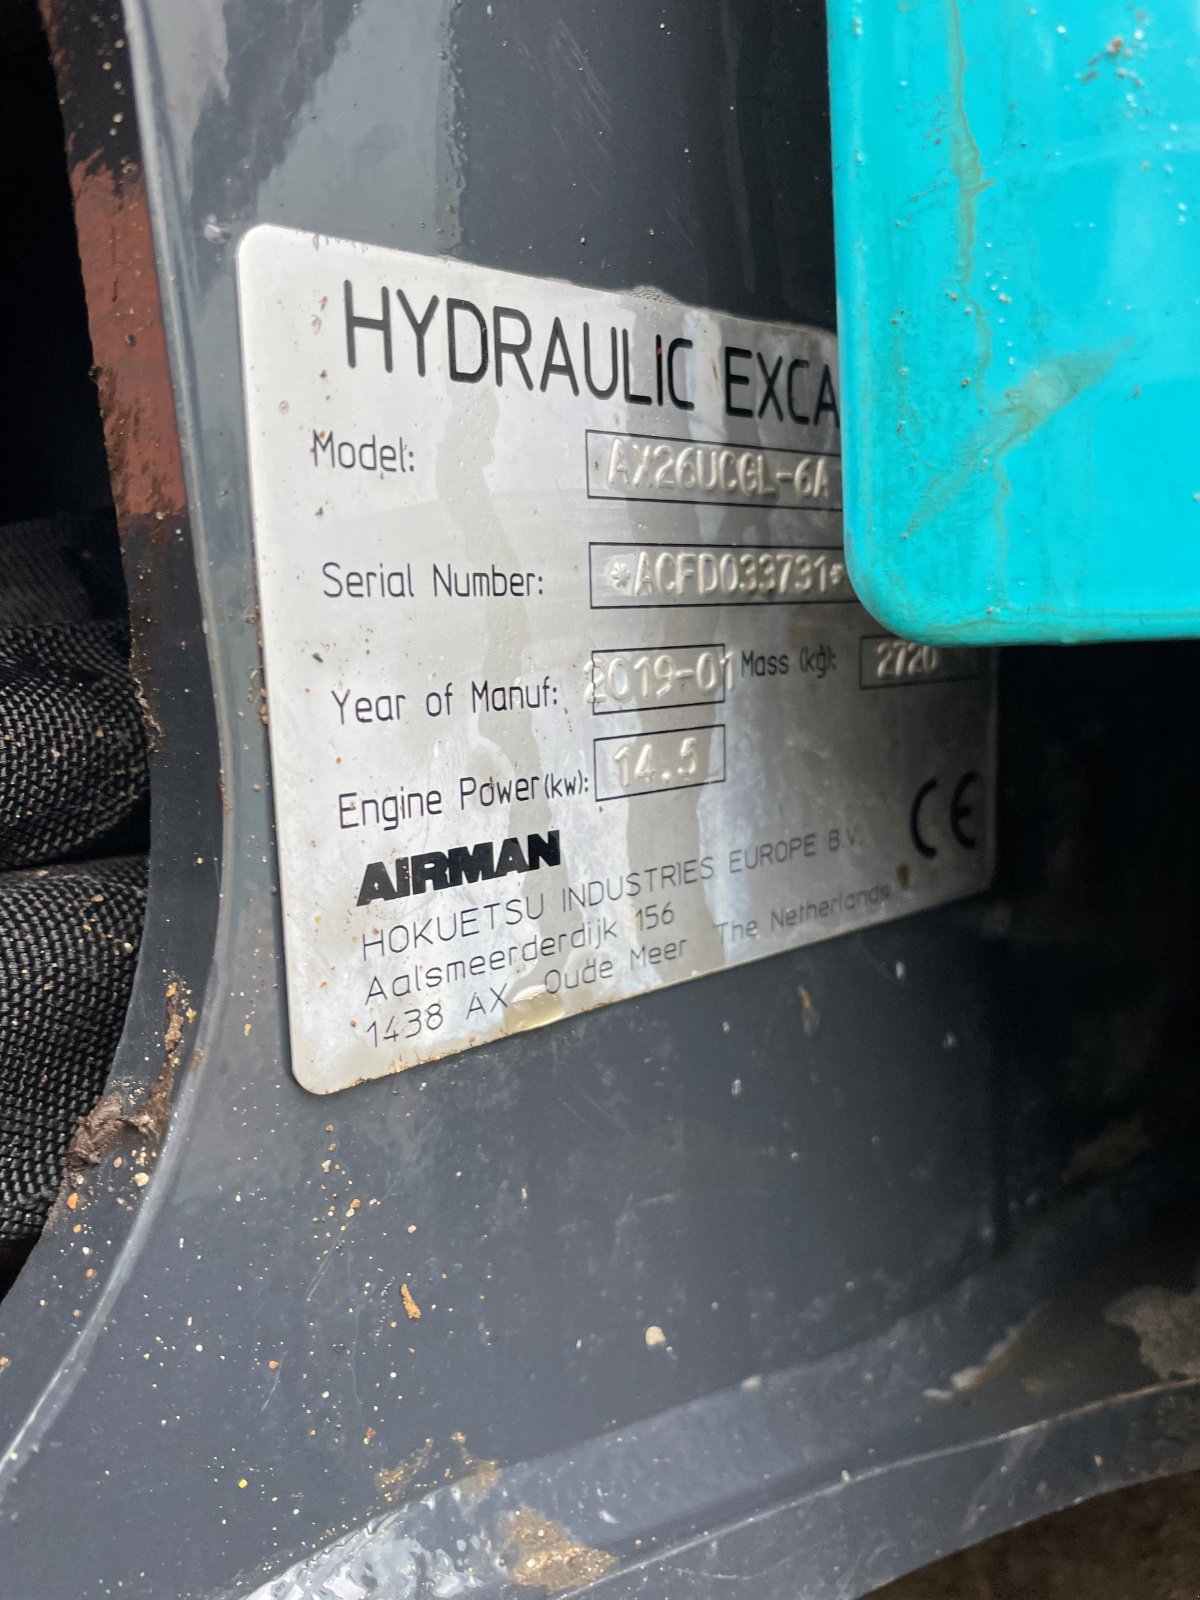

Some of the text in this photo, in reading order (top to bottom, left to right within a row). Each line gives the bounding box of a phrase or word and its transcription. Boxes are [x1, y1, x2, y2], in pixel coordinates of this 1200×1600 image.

[343, 279, 694, 411] HYDRAULIC
[310, 429, 416, 474] Model:
[322, 561, 544, 598] Serial Number:
[583, 650, 735, 704] 2019-01
[740, 649, 790, 678] Mass
[331, 676, 558, 725] Year of Manuf:
[614, 736, 698, 787] 14.5
[338, 786, 443, 831] Engine
[356, 829, 561, 907] AIRMAN
[362, 892, 544, 961] HOKUETSU
[562, 857, 715, 913] INDUSTRIES
[729, 833, 816, 874] EUROPE
[365, 902, 675, 1006] Aalsmeerderdijk 156
[366, 881, 892, 1048] 1438 AX Oude Meer The Netherlands
